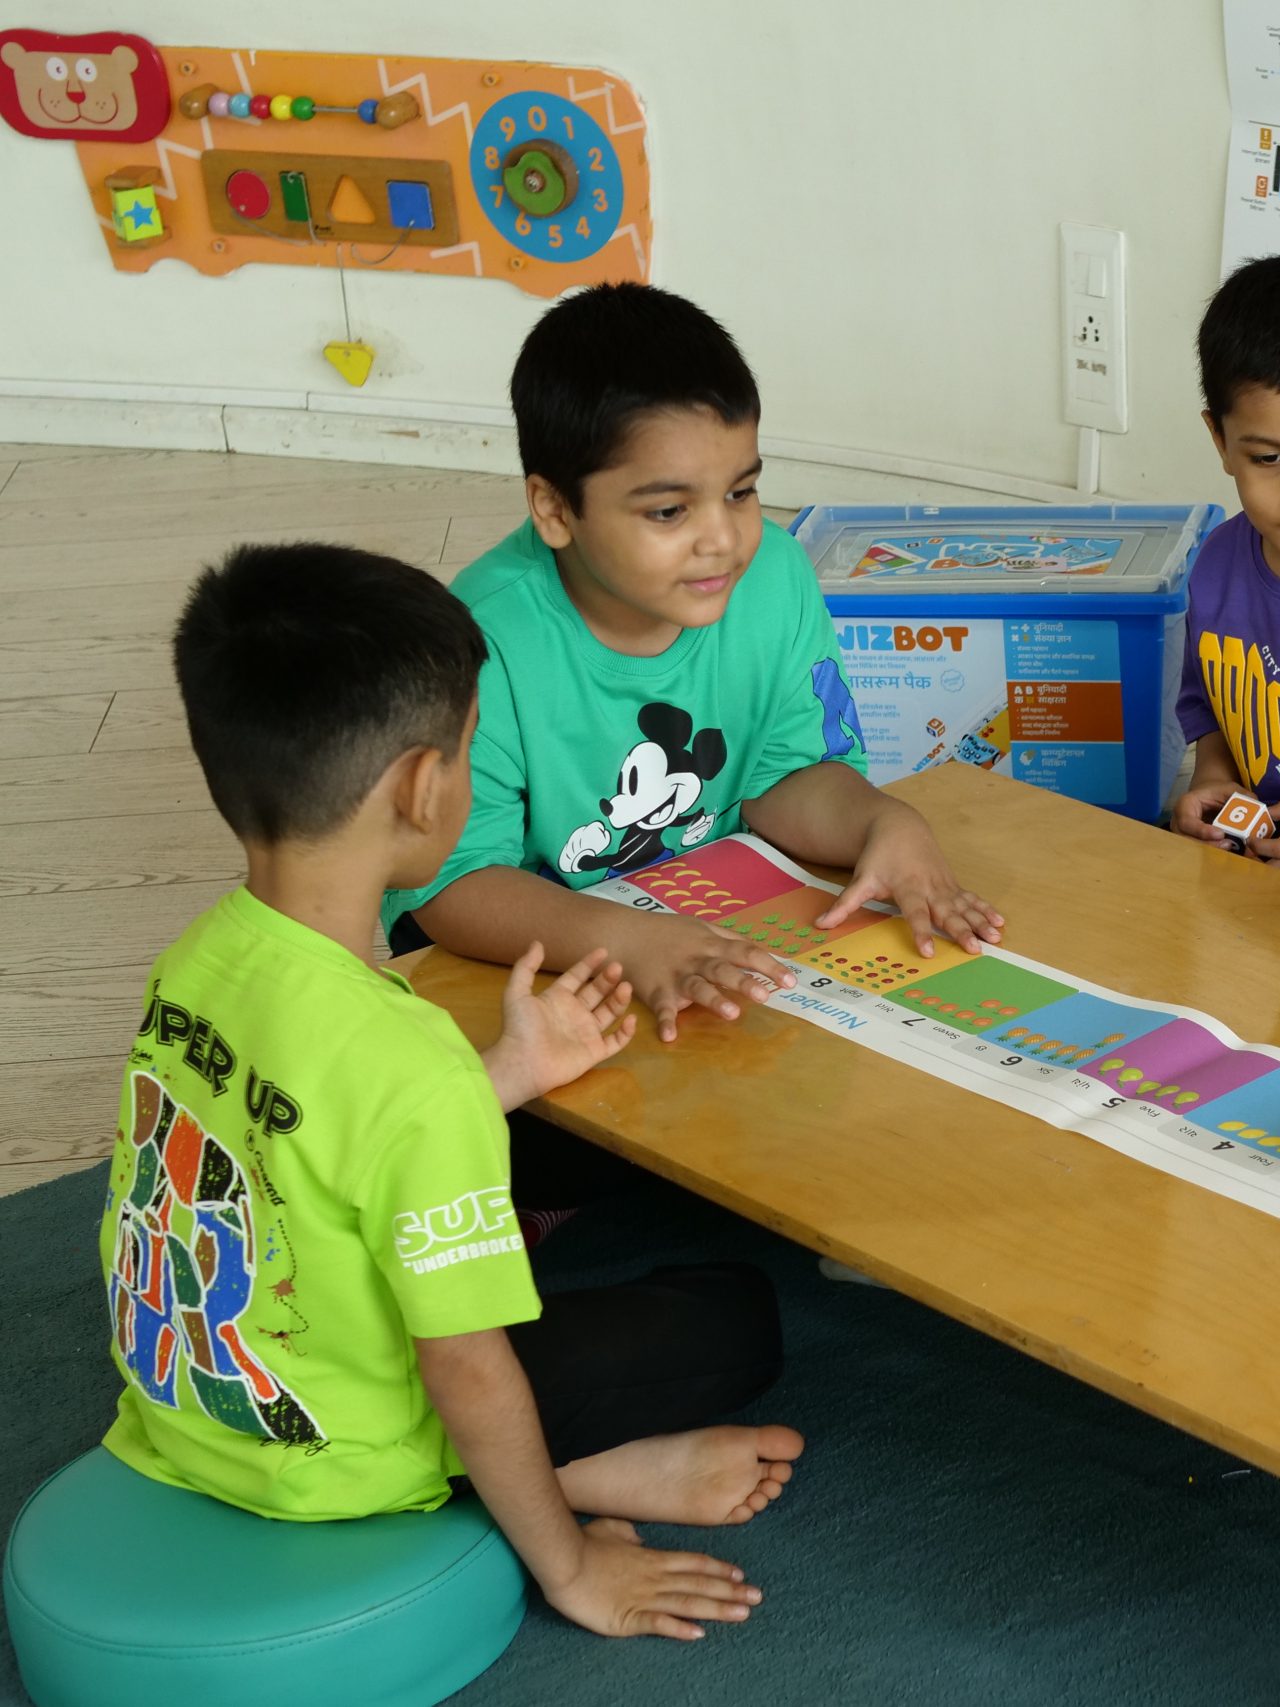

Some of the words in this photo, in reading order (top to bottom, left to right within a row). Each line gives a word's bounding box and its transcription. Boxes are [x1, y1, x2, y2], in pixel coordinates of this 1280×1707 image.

[500, 117, 515, 141] 9
[528, 106, 546, 131] 0
[562, 117, 574, 140] 1
[484, 146, 500, 170] 8
[588, 148, 604, 171] 2
[489, 185, 504, 208] 7
[593, 189, 608, 212] 3
[515, 210, 531, 236] 6
[576, 216, 591, 239] 4
[548, 225, 563, 247] 5
[1261, 645, 1280, 676] CITY
[903, 671, 931, 689] पैक
[1229, 806, 1248, 823] 6
[810, 977, 833, 988] 8
[779, 992, 868, 1030] Number
[902, 1018, 926, 1028] 7
[933, 1026, 960, 1041] Seven
[1000, 1056, 1023, 1067] 6
[244, 1065, 303, 1138] UP
[1102, 1096, 1127, 1109] 5
[1139, 1105, 1160, 1118] Five
[1211, 1140, 1234, 1153] 4
[1248, 1153, 1274, 1168] Four
